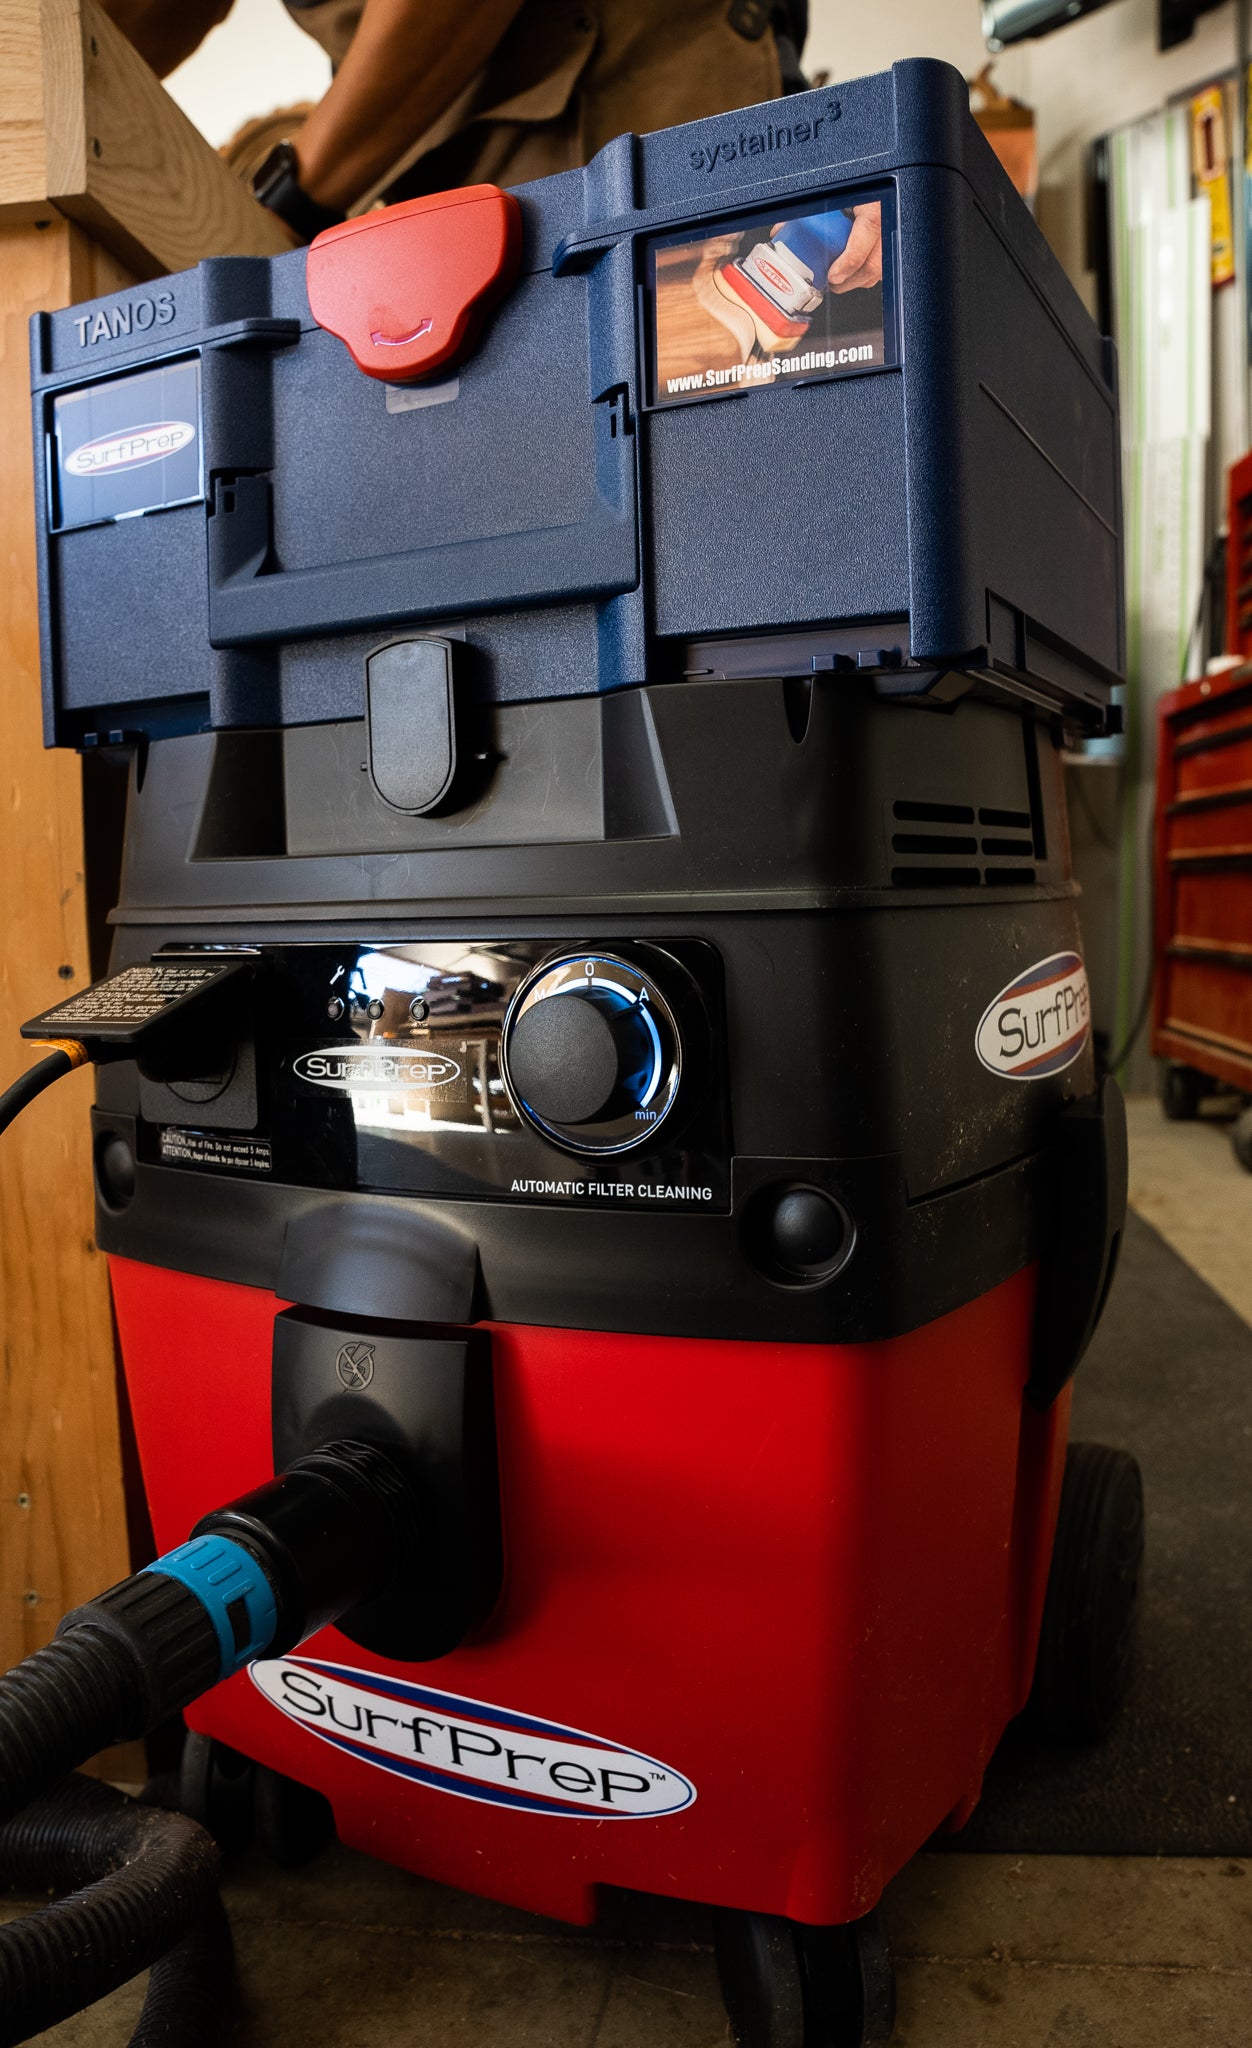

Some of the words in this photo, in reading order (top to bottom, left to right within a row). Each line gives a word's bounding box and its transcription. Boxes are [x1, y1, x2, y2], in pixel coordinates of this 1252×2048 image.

[74, 291, 176, 347] TANOS
[666, 344, 873, 393] www.SurfPrepSanding.com
[534, 988, 546, 1000] M
[639, 986, 650, 1001] A
[998, 983, 1087, 1057] SurfPre
[634, 1108, 657, 1121] min
[215, 1142, 222, 1151] Do
[223, 1144, 231, 1152] not
[233, 1145, 249, 1154] exceed
[511, 1179, 585, 1195] AUTOMATIC
[588, 1182, 634, 1197] FILTER
[637, 1184, 713, 1200] CLEANING
